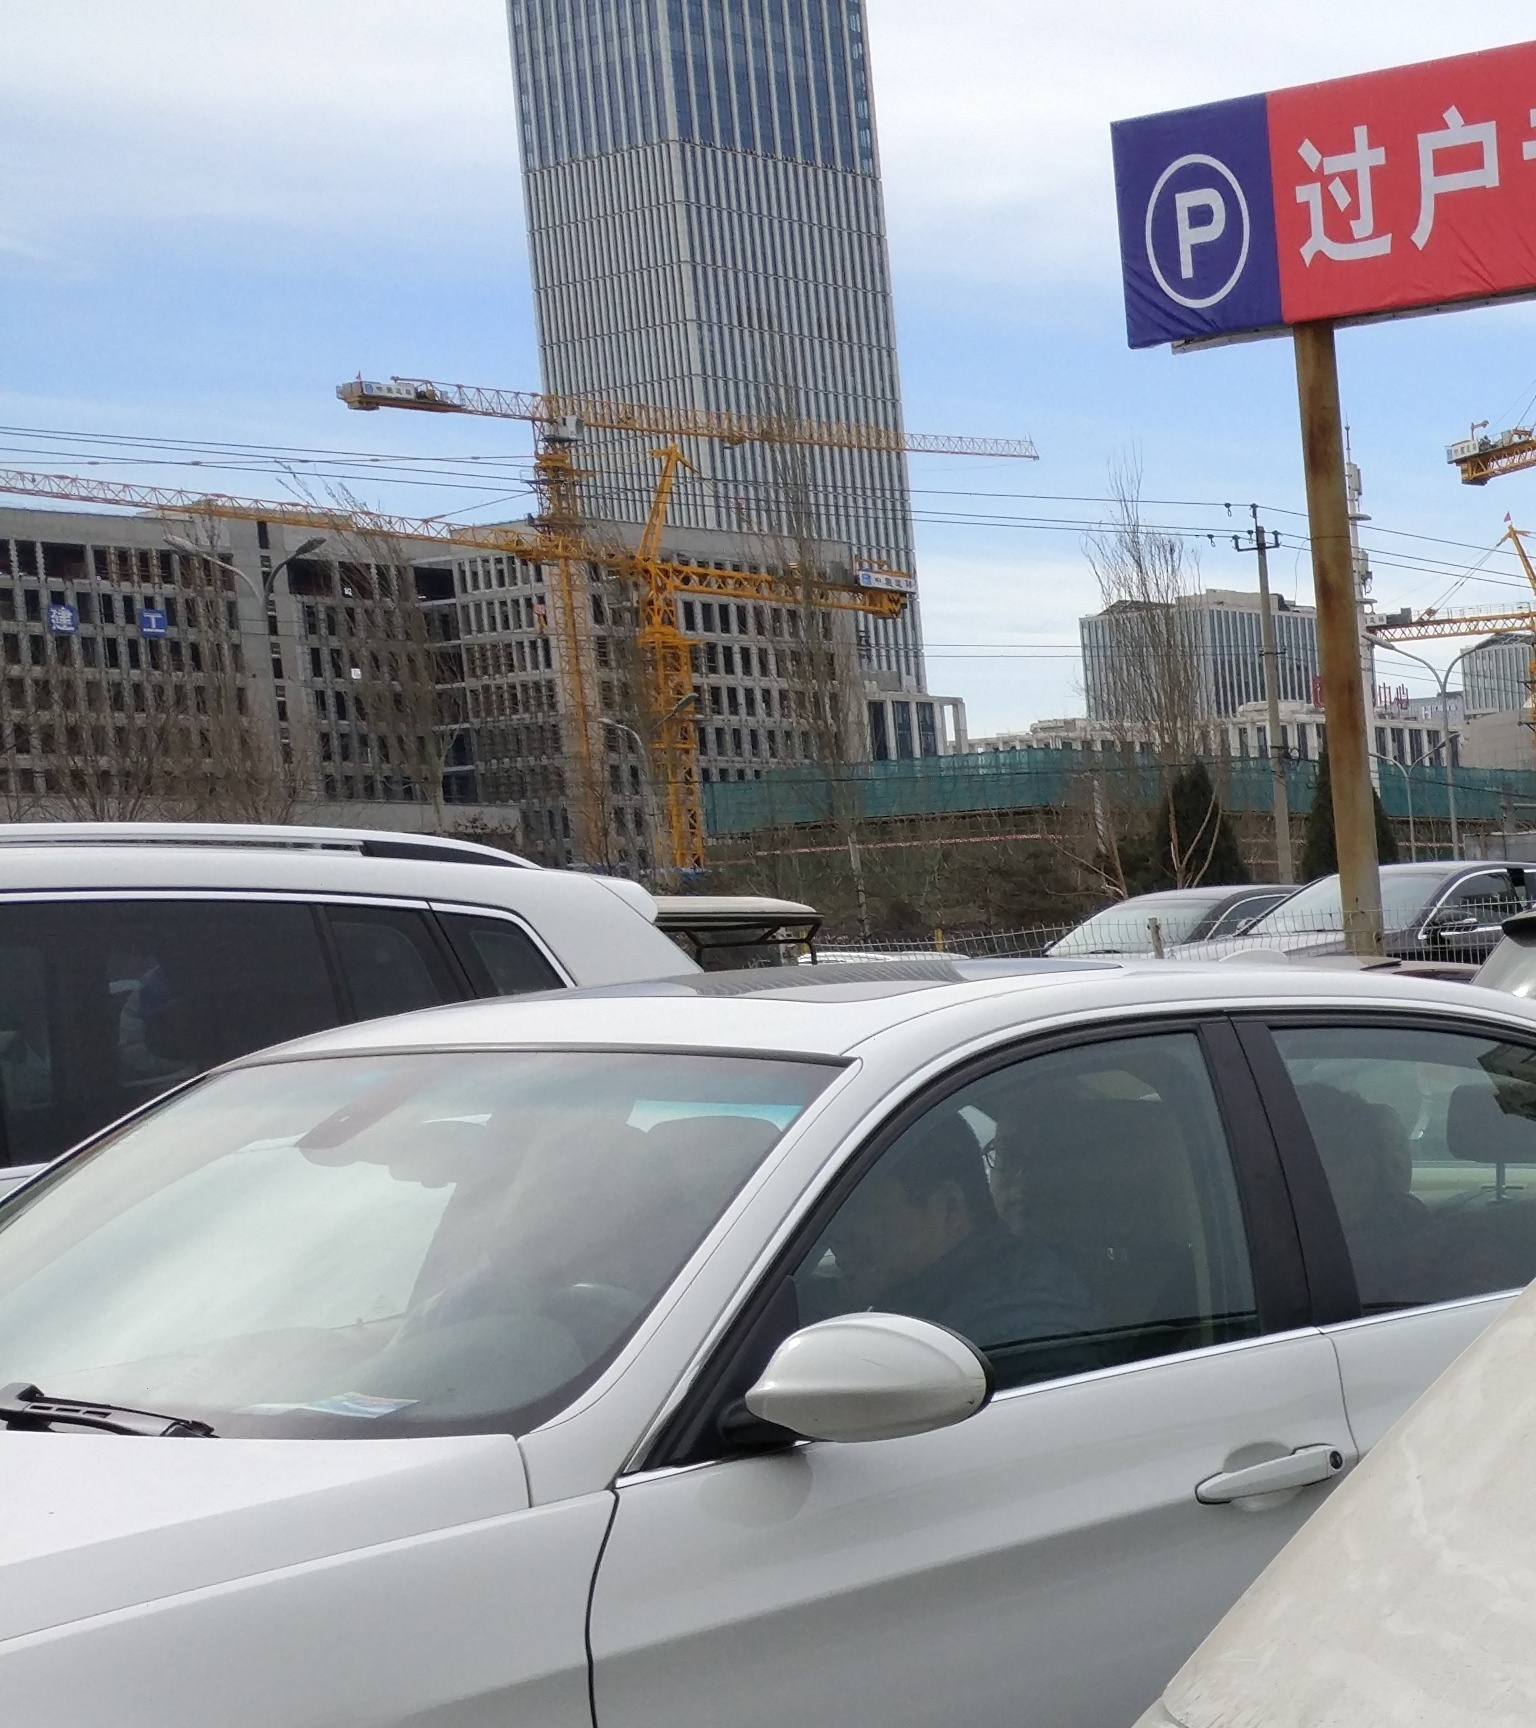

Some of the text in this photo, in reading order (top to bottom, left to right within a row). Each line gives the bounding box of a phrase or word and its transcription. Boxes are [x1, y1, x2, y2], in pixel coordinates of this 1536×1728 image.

[1175, 187, 1226, 279] P
[51, 606, 166, 633] 建 工
